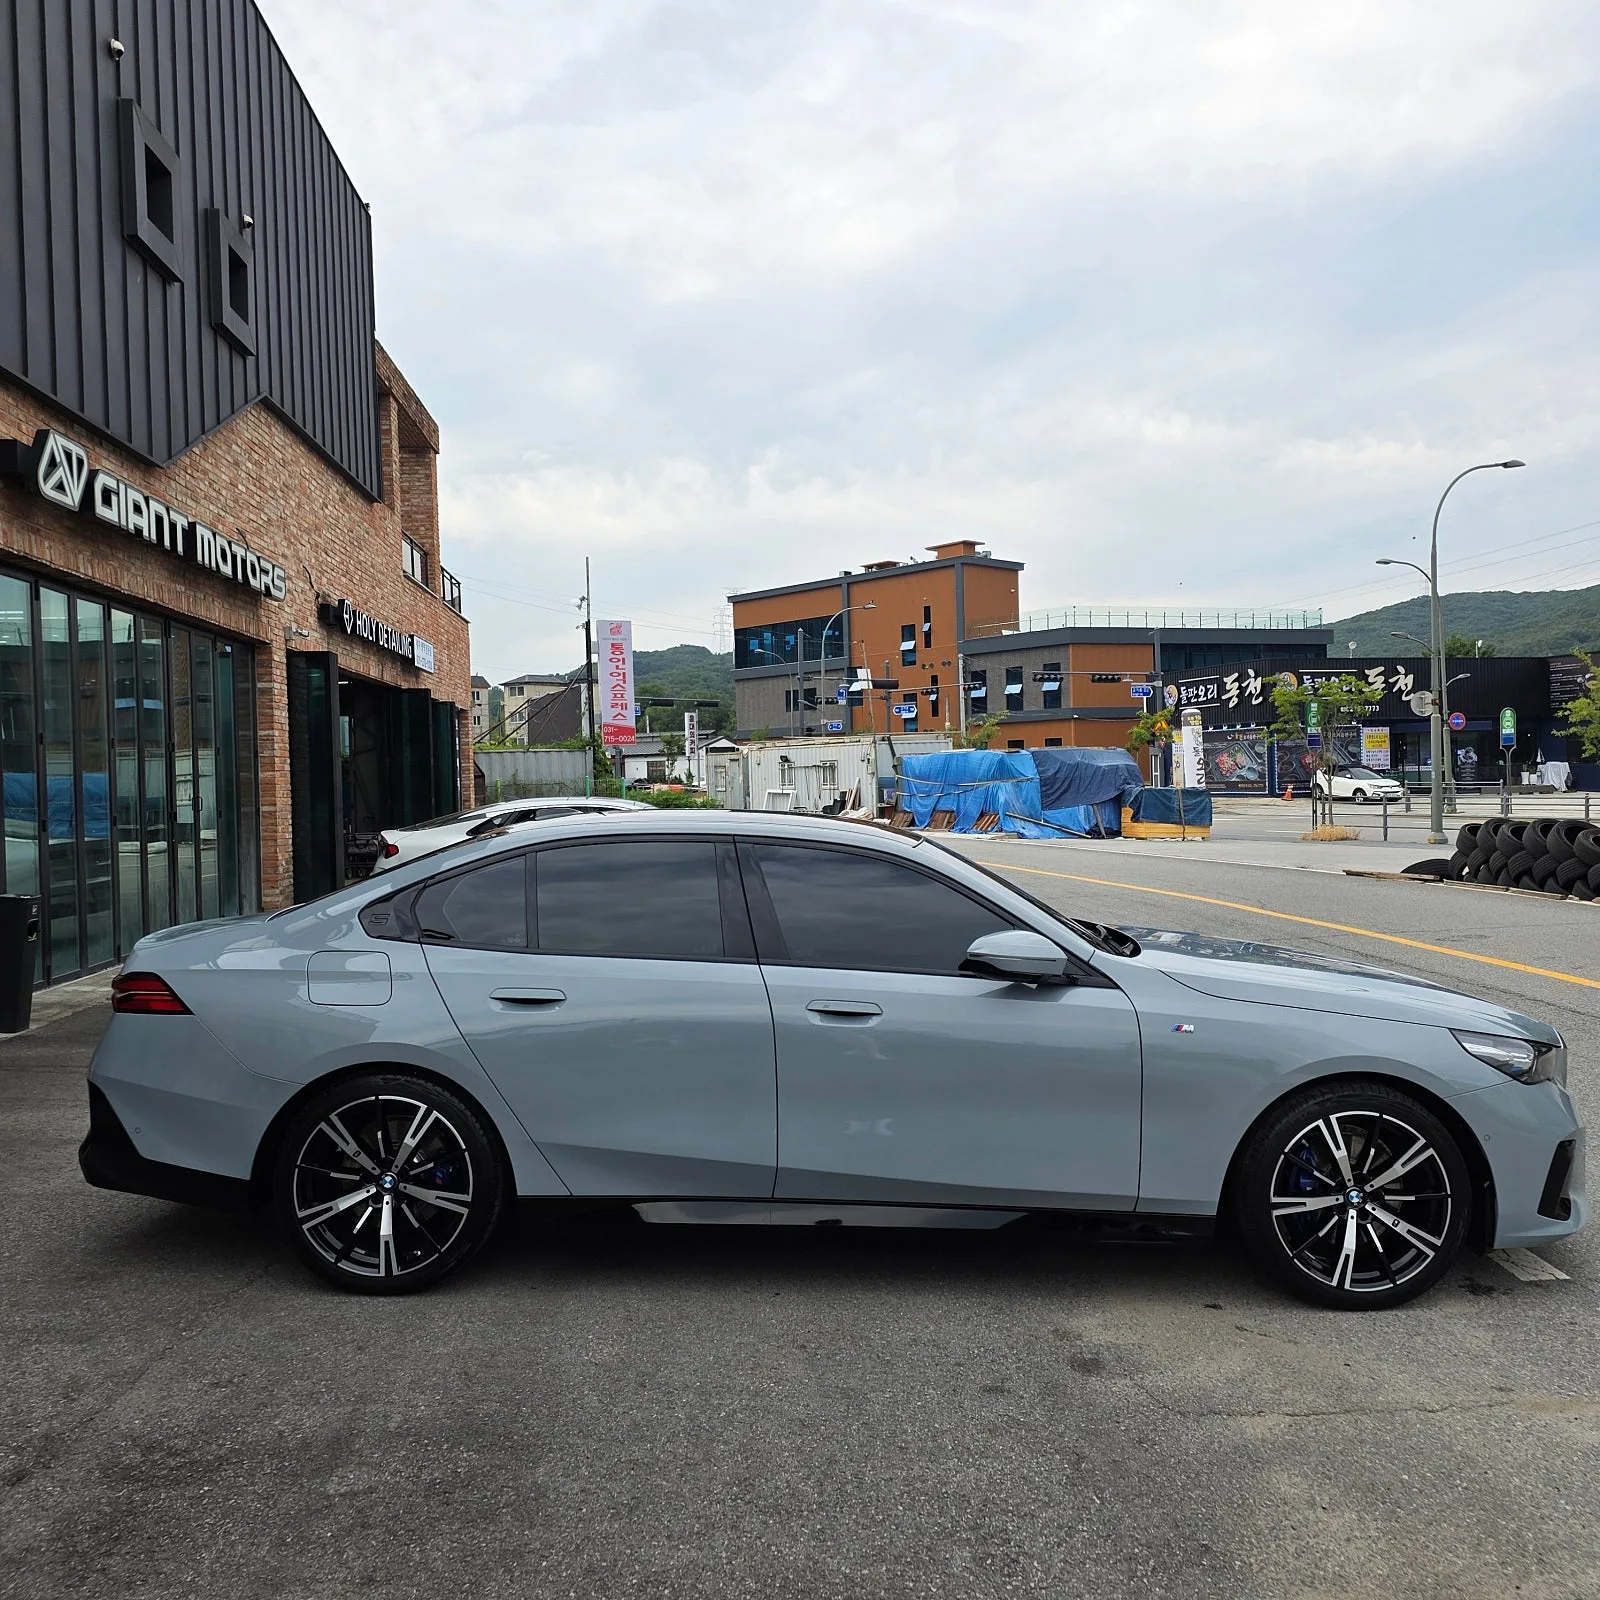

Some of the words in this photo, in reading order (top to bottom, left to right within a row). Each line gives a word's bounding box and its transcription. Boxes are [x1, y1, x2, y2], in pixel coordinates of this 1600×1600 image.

[94, 472, 189, 556] GIANT
[196, 523, 286, 600] MOTORS
[356, 611, 377, 643] HOLY
[379, 622, 412, 659] DETAILING
[609, 643, 628, 721] 통인익스프레스
[1221, 668, 1263, 709] 동천
[604, 735, 635, 743] 715-0024
